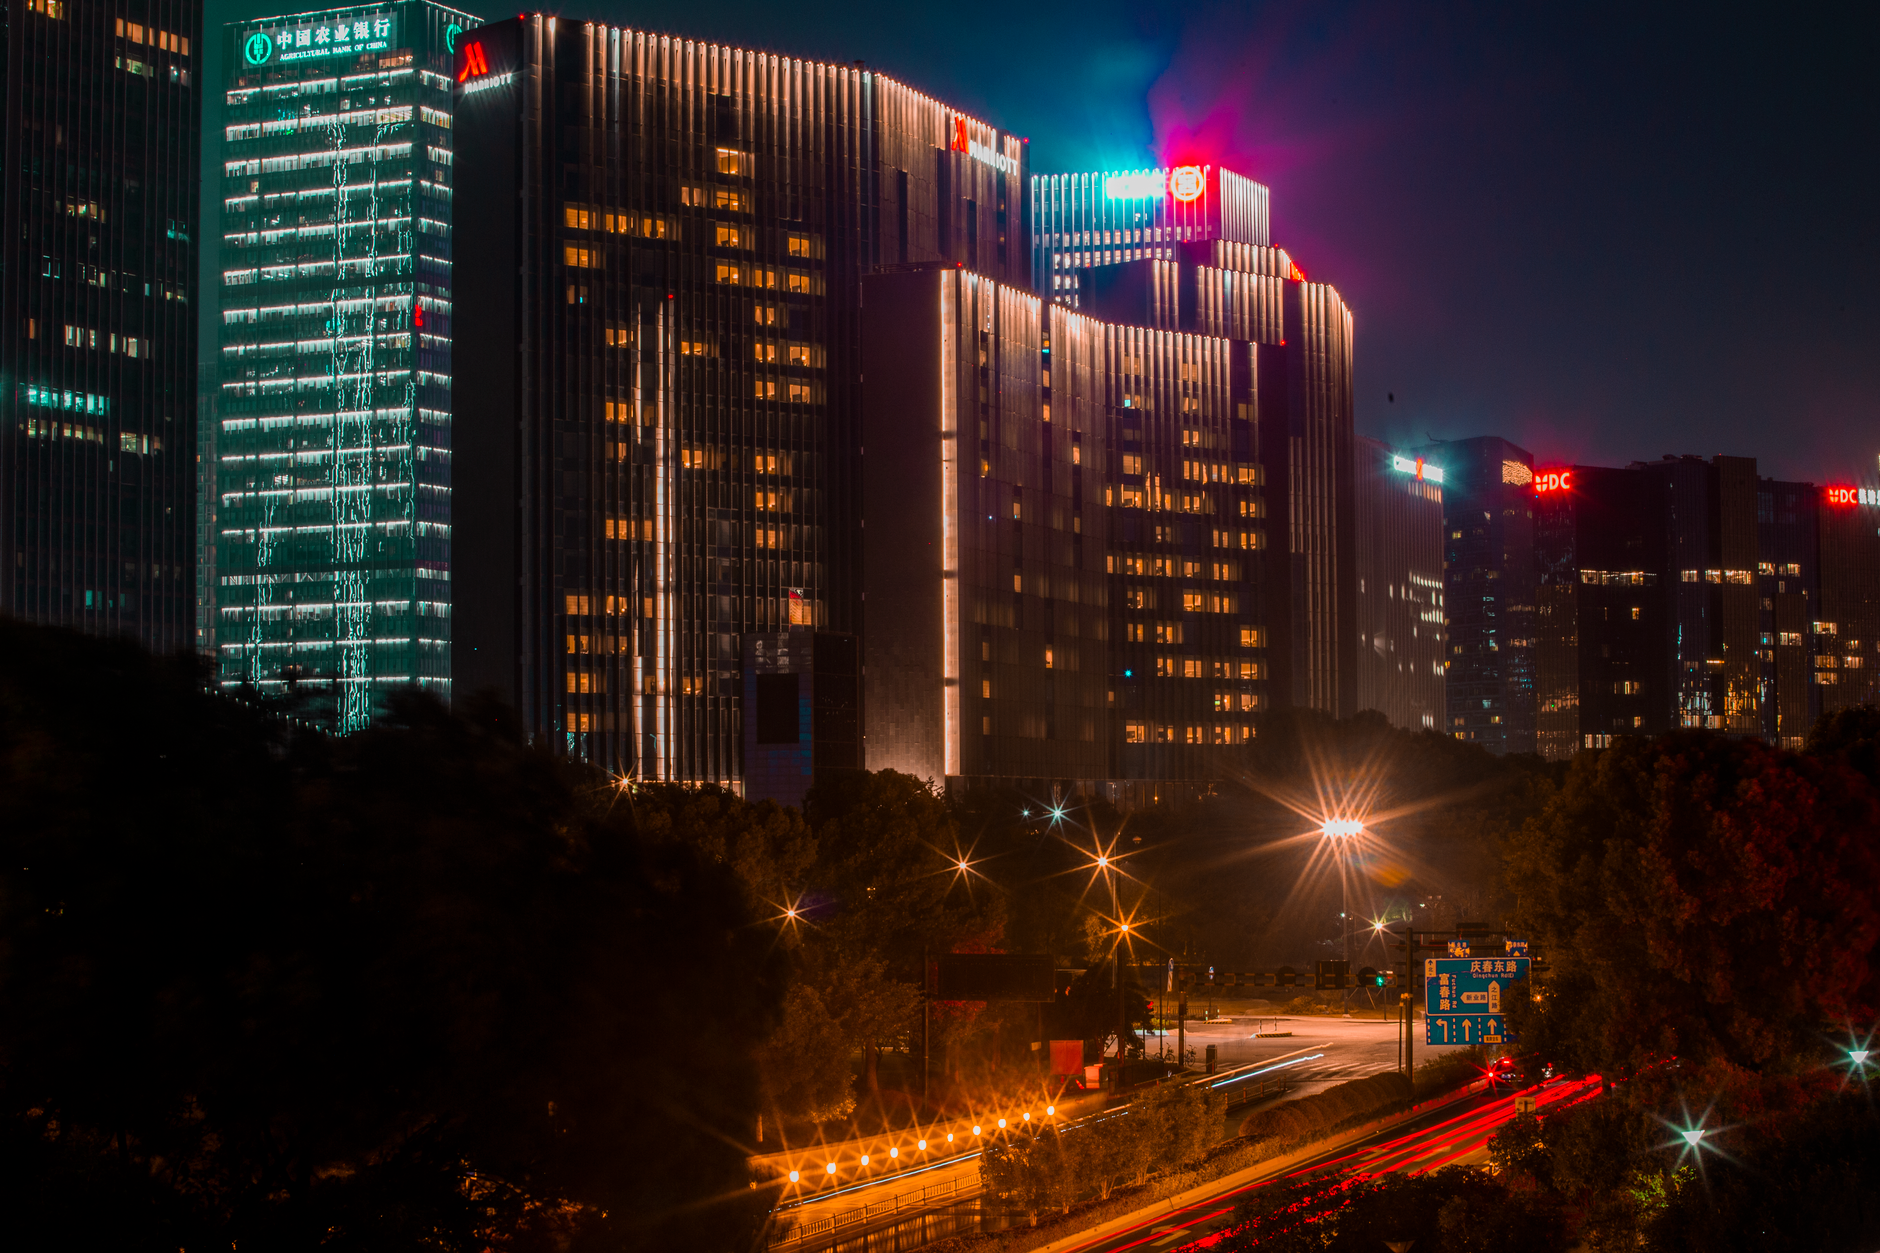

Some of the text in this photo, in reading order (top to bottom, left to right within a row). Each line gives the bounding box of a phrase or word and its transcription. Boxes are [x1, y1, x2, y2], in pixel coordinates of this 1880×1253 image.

[277, 18, 390, 50] 中国农业银行
[280, 41, 387, 61] AGRICULTURAL BANK OF CHINA
[464, 72, 512, 94] MARRIOTT
[1470, 960, 1517, 973] 庆春东路
[1439, 973, 1451, 1011] 富春路
